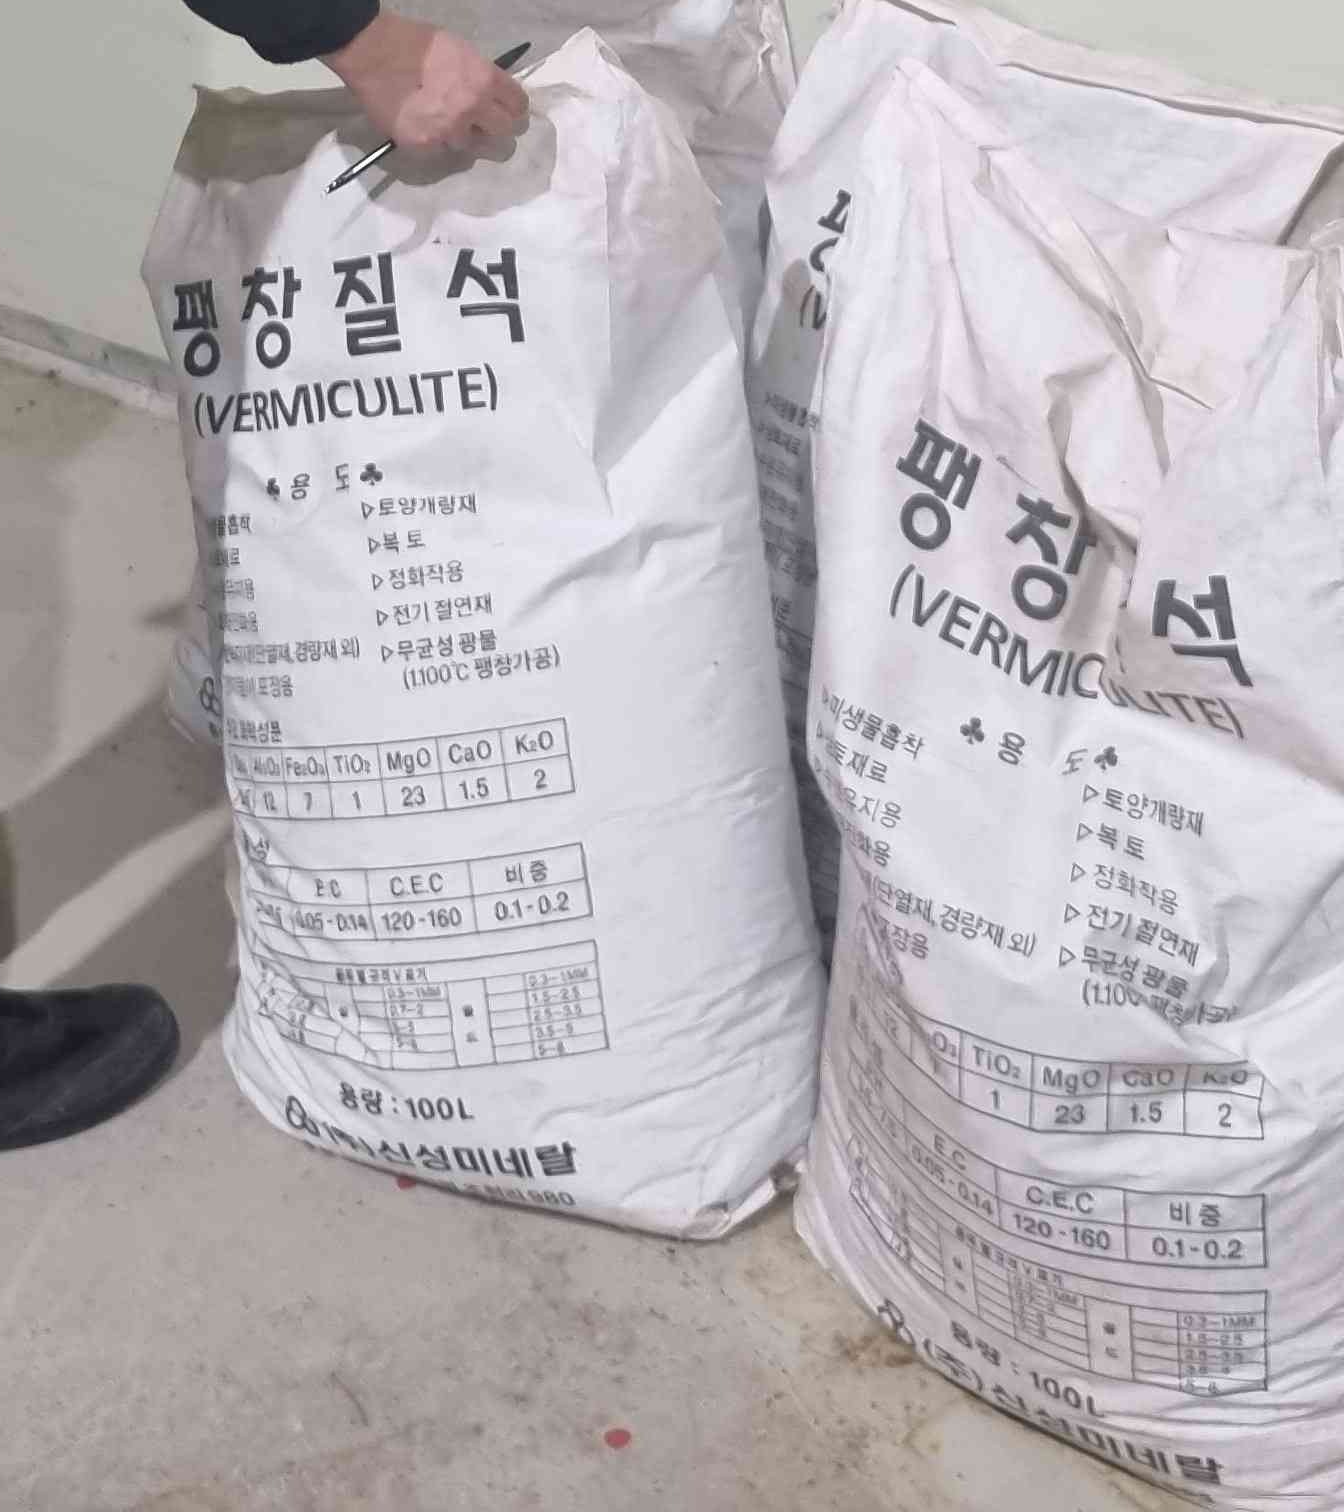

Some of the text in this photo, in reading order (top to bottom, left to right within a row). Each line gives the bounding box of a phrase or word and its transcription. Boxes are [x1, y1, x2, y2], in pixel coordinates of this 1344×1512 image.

[193, 363, 498, 438] (VERMICULITE)
[387, 747, 431, 775] MgO
[448, 740, 491, 764] CaO
[402, 786, 426, 807] 23
[460, 778, 489, 800] 1.5
[534, 770, 547, 789] 2
[1087, 903, 1132, 938] 전기
[1042, 1067, 1102, 1093] MgO
[990, 1088, 1233, 1128] 1 23 1.5 2
[1026, 1186, 1096, 1215] C.E.C
